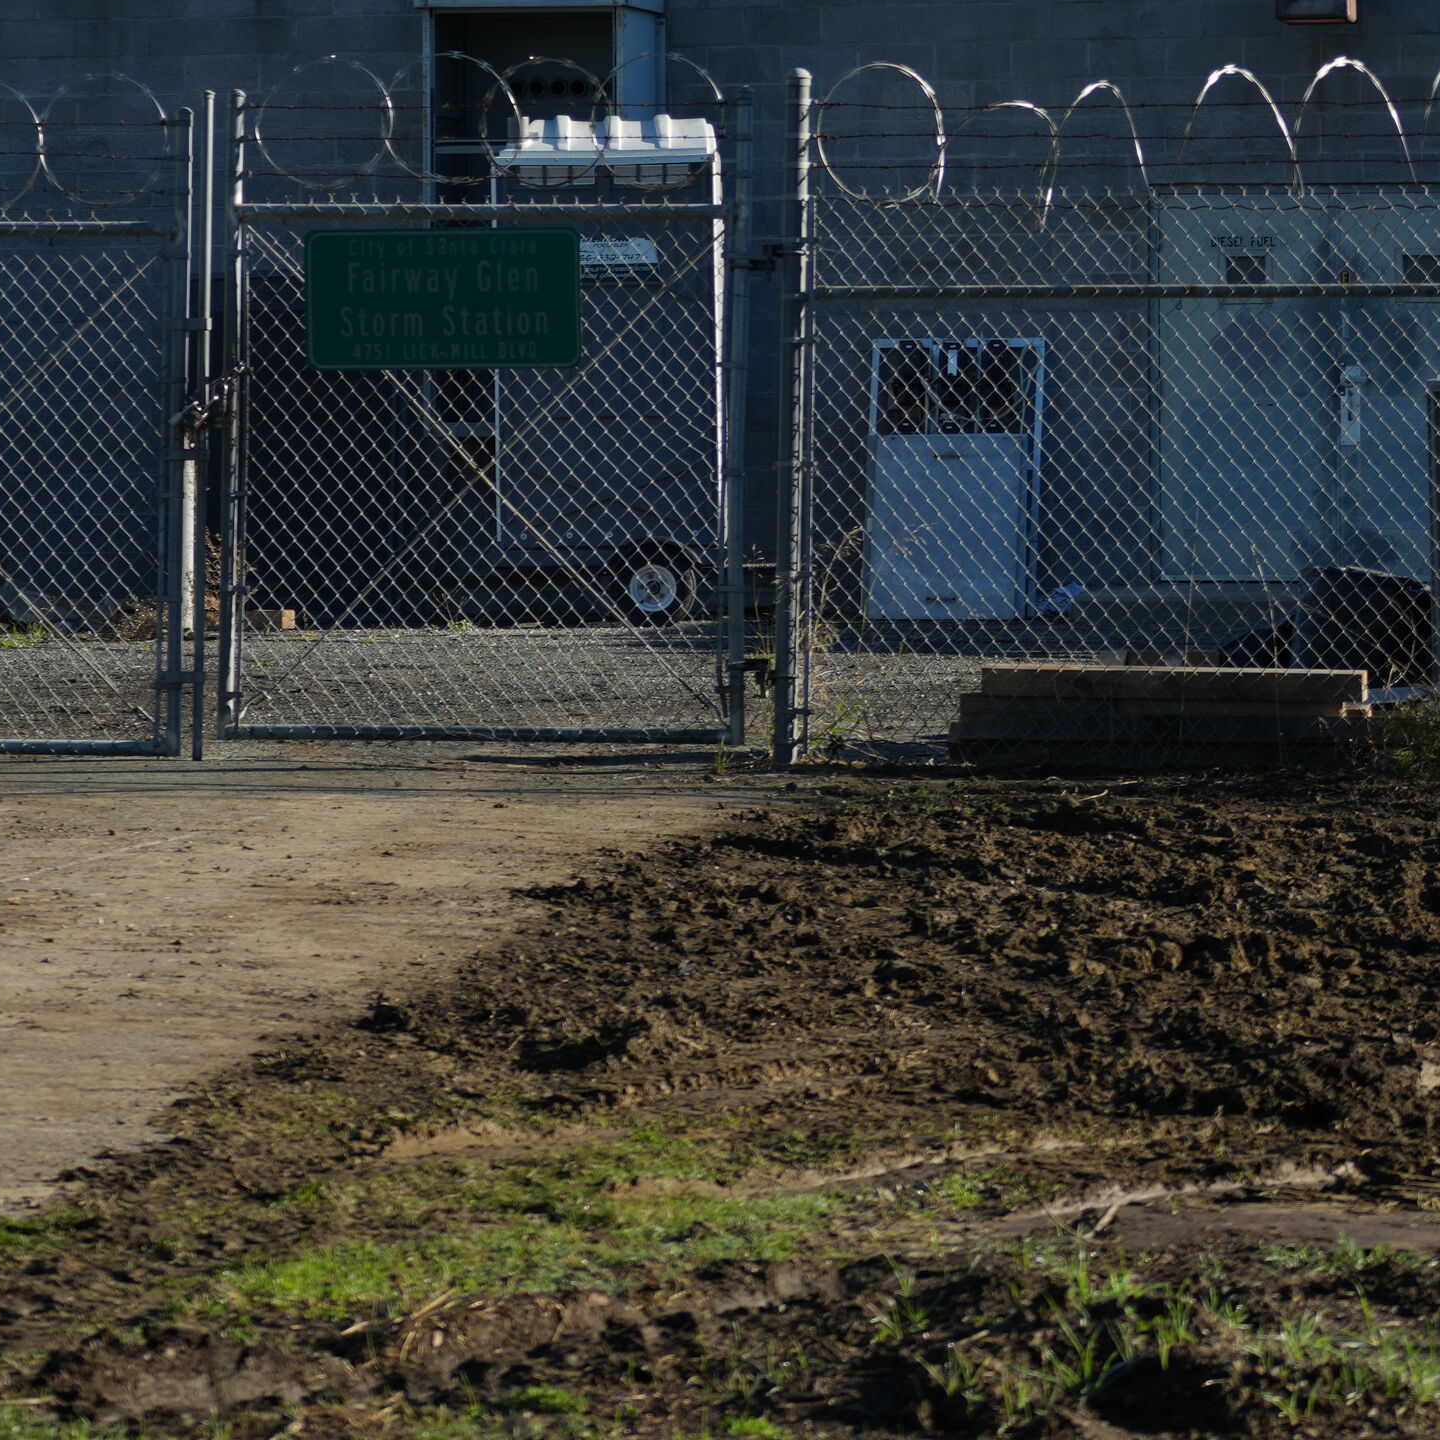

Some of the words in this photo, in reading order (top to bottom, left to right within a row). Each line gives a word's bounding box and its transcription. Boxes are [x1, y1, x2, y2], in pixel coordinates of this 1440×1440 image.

[349, 238, 385, 260] City
[396, 238, 414, 256] of
[425, 238, 478, 256] Santa
[489, 237, 537, 255] Clara
[1211, 235, 1246, 248] DIESEL
[1250, 235, 1277, 247] FUEL
[347, 260, 458, 300] Fairway
[477, 259, 540, 293] Glen
[340, 306, 424, 338] Storm
[442, 304, 549, 337] Station
[352, 343, 392, 361] 4751
[403, 343, 443, 360] LICK
[451, 342, 488, 360] MILL
[498, 341, 537, 359] BLVD
